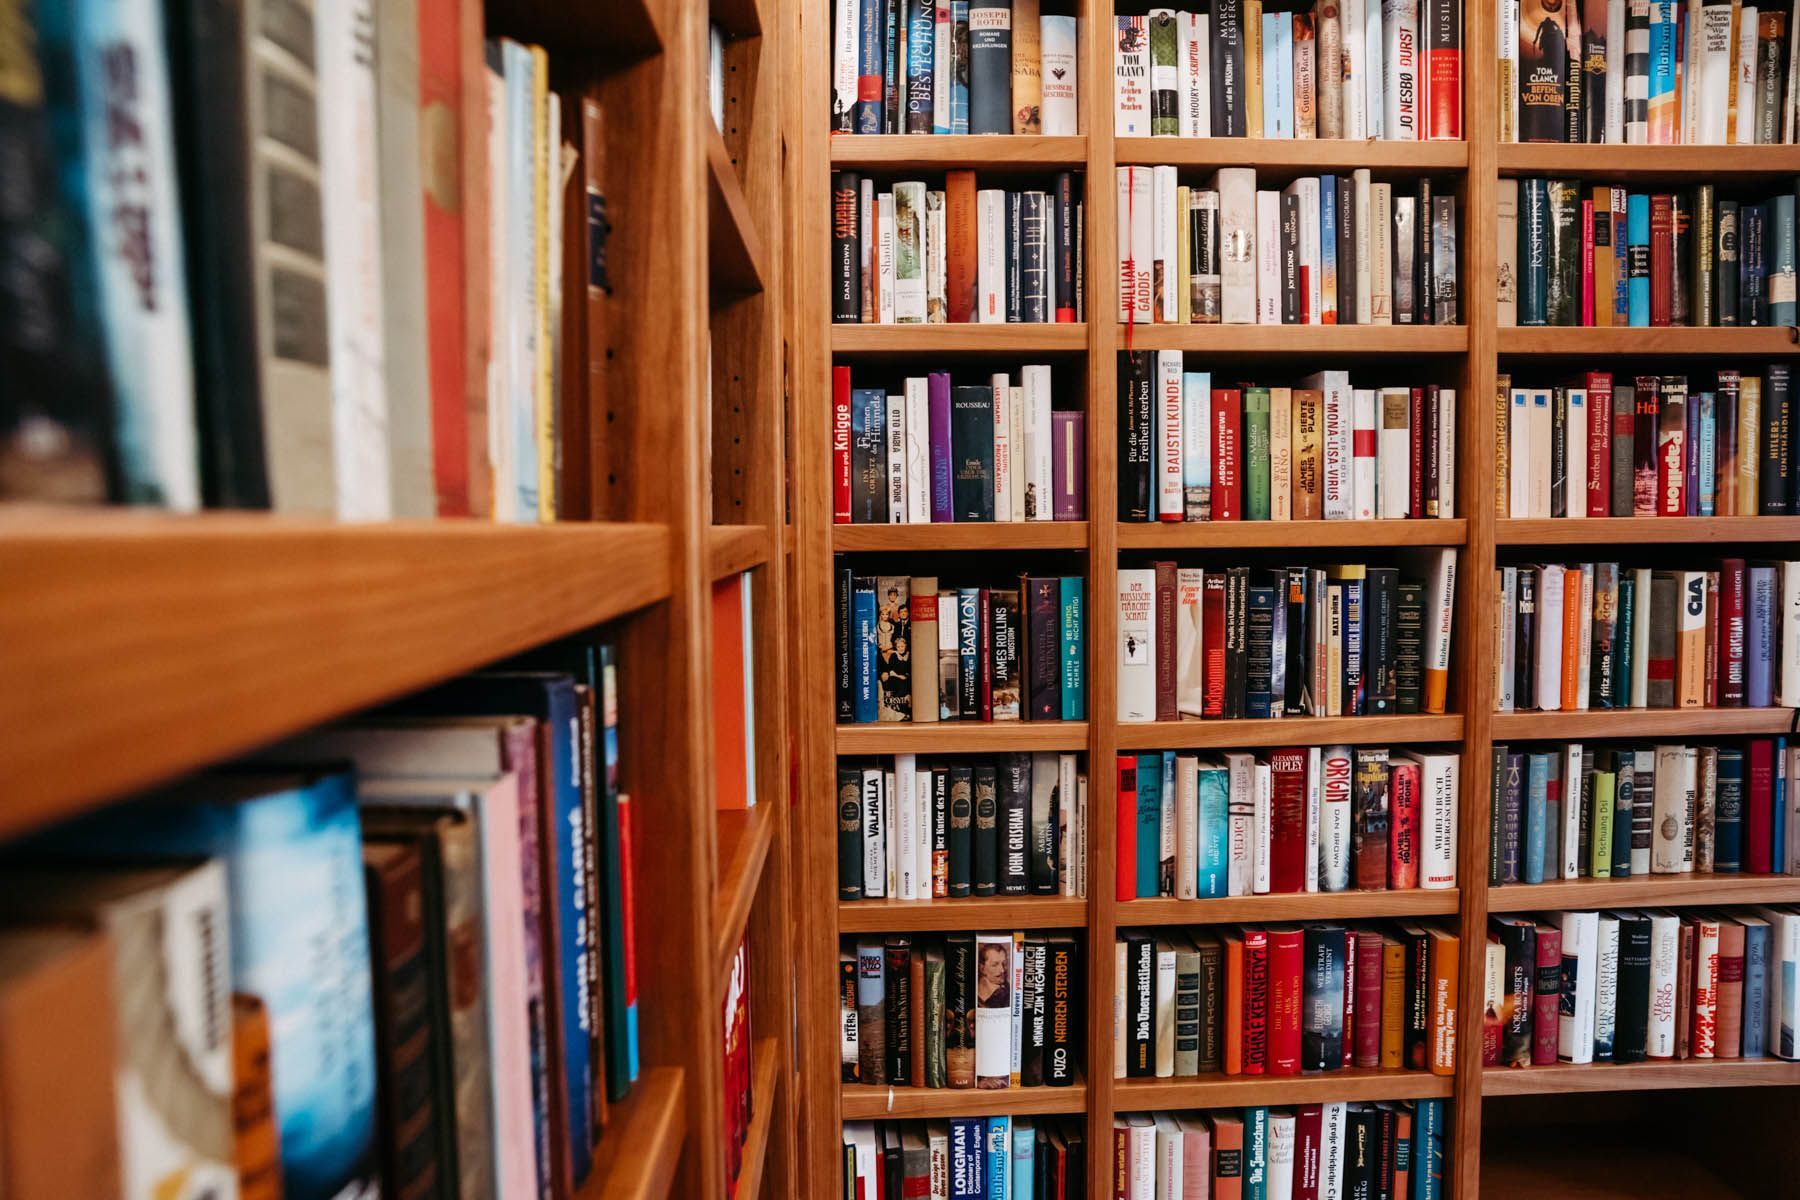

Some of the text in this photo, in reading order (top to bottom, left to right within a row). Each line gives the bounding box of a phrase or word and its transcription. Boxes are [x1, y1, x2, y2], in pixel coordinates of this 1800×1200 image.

[1219, 3, 1228, 38] MARC
[1656, 0, 1671, 76] Mathematik
[910, 18, 921, 114] JOHN GRISHAM
[1123, 55, 1140, 64] TOM
[1400, 25, 1413, 68] DURST
[1118, 67, 1145, 76] CLANCY
[1189, 40, 1202, 118] KHOURY SCRIPTUM
[1530, 74, 1558, 83] CLANCY
[1566, 61, 1580, 110] Empfang
[1764, 18, 1777, 139] GASKIN DIE LADY
[1400, 72, 1413, 131] JO NESBØ
[1522, 94, 1562, 102] VON OBEN
[836, 189, 857, 239] SAKRILEG
[1531, 202, 1542, 267] RASPUTIN
[880, 232, 891, 275] Shaolin
[1122, 260, 1135, 311] WILLIAM
[1138, 272, 1150, 312] GADDIS
[834, 404, 851, 450] Knigge
[856, 406, 874, 449] Flammen
[871, 396, 881, 442] Himmels
[892, 410, 900, 428] OTTO
[1139, 381, 1148, 462] Freiheit sterben
[1167, 380, 1180, 474] BAUSTILKUNDE
[1249, 424, 1257, 454] Medica
[1300, 400, 1308, 434] SIEBTE
[1770, 420, 1778, 459] HITLERS
[1779, 402, 1789, 478] KUNSTHÄNDLER
[1128, 448, 1137, 462] Für
[1327, 404, 1338, 501] MONA-LISA-VIRUS
[1588, 395, 1602, 490] Sterben für Jerusalem
[894, 476, 902, 504] DEPONIE
[1280, 449, 1288, 488] SERNO
[1300, 460, 1308, 491] JAMES
[1664, 430, 1683, 512] Papillon
[1444, 565, 1453, 606] überzeugen
[960, 595, 976, 656] BABYLON
[996, 608, 1008, 680] JAMES ROLLINS
[1008, 628, 1016, 660] SANDSTURM
[1228, 626, 1236, 648] Physik
[1238, 626, 1246, 652] Technik
[1442, 608, 1450, 632] Ehrlich
[1347, 623, 1360, 686] PC-FÜHRER DURCH DIE
[1600, 654, 1610, 696] fritz sitte
[1729, 618, 1742, 684] JOHN GRISHAM
[1272, 761, 1303, 771] RIPLEY
[1326, 758, 1350, 803] ORIGIN
[868, 778, 879, 838] VALHALLA
[1434, 777, 1444, 850] WILHELM BUSCH
[1443, 766, 1453, 860] BILDERGESCHICHTEN
[1598, 800, 1608, 856] Dschuang Dsi
[1684, 790, 1694, 862] Der kleine Sündenfall
[936, 775, 946, 894] Jules Verne Der Kurier des Zaren
[1008, 808, 1024, 875] JOHN GRISHAM
[1038, 824, 1046, 852] SABINE
[1234, 818, 1244, 861] MEDICI
[1012, 968, 1022, 1018] forever young
[1024, 947, 1035, 1010] WILLI HEINRICH
[1032, 947, 1046, 1047] MÄNNER ZUM WEGWERFEN
[1137, 944, 1150, 1040] Die Unersättlichen
[1512, 966, 1523, 1034] NORA ROBERTS
[1598, 952, 1610, 1038] JOHN GRISHAM
[1654, 988, 1664, 1016] WOLF
[1660, 984, 1673, 1022] SERNO
[846, 980, 856, 1042] PETERS TODESHAFT
[1054, 952, 1068, 1078] PUZO NARREN STERBEN
[1250, 950, 1265, 1065] JOHN KENNEDY?
[1274, 1016, 1282, 1030] DIE
[1314, 1000, 1324, 1030] ELIZABETH
[1323, 1004, 1332, 1026] GEORGE
[1331, 1106, 1340, 1120] Die
[956, 1126, 966, 1195] LONGMAN
[967, 1154, 973, 1162] of
[974, 1125, 982, 1194] Contemporary English
[1250, 1110, 1264, 1184] Die Janitscharen
